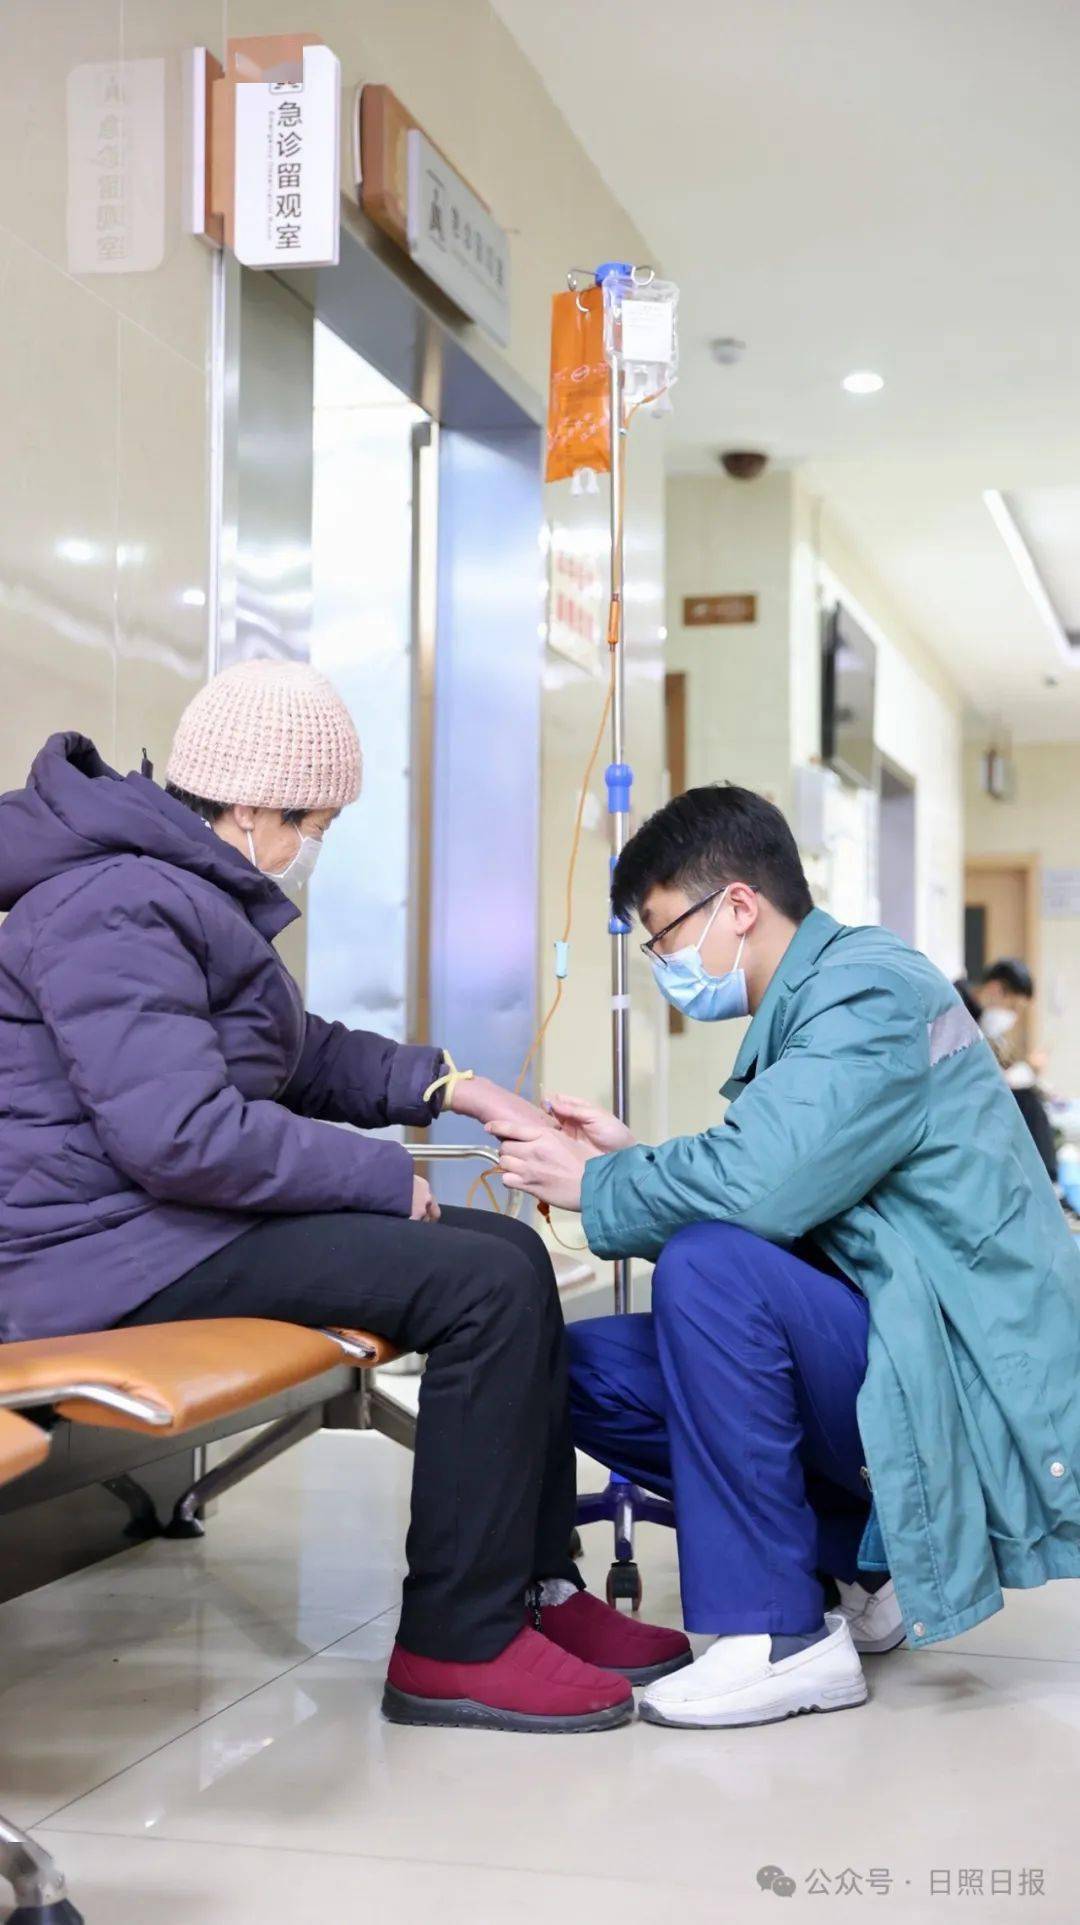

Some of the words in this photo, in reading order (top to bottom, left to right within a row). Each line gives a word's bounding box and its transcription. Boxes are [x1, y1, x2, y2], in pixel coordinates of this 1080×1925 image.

[275, 101, 303, 249] 急诊留观室
